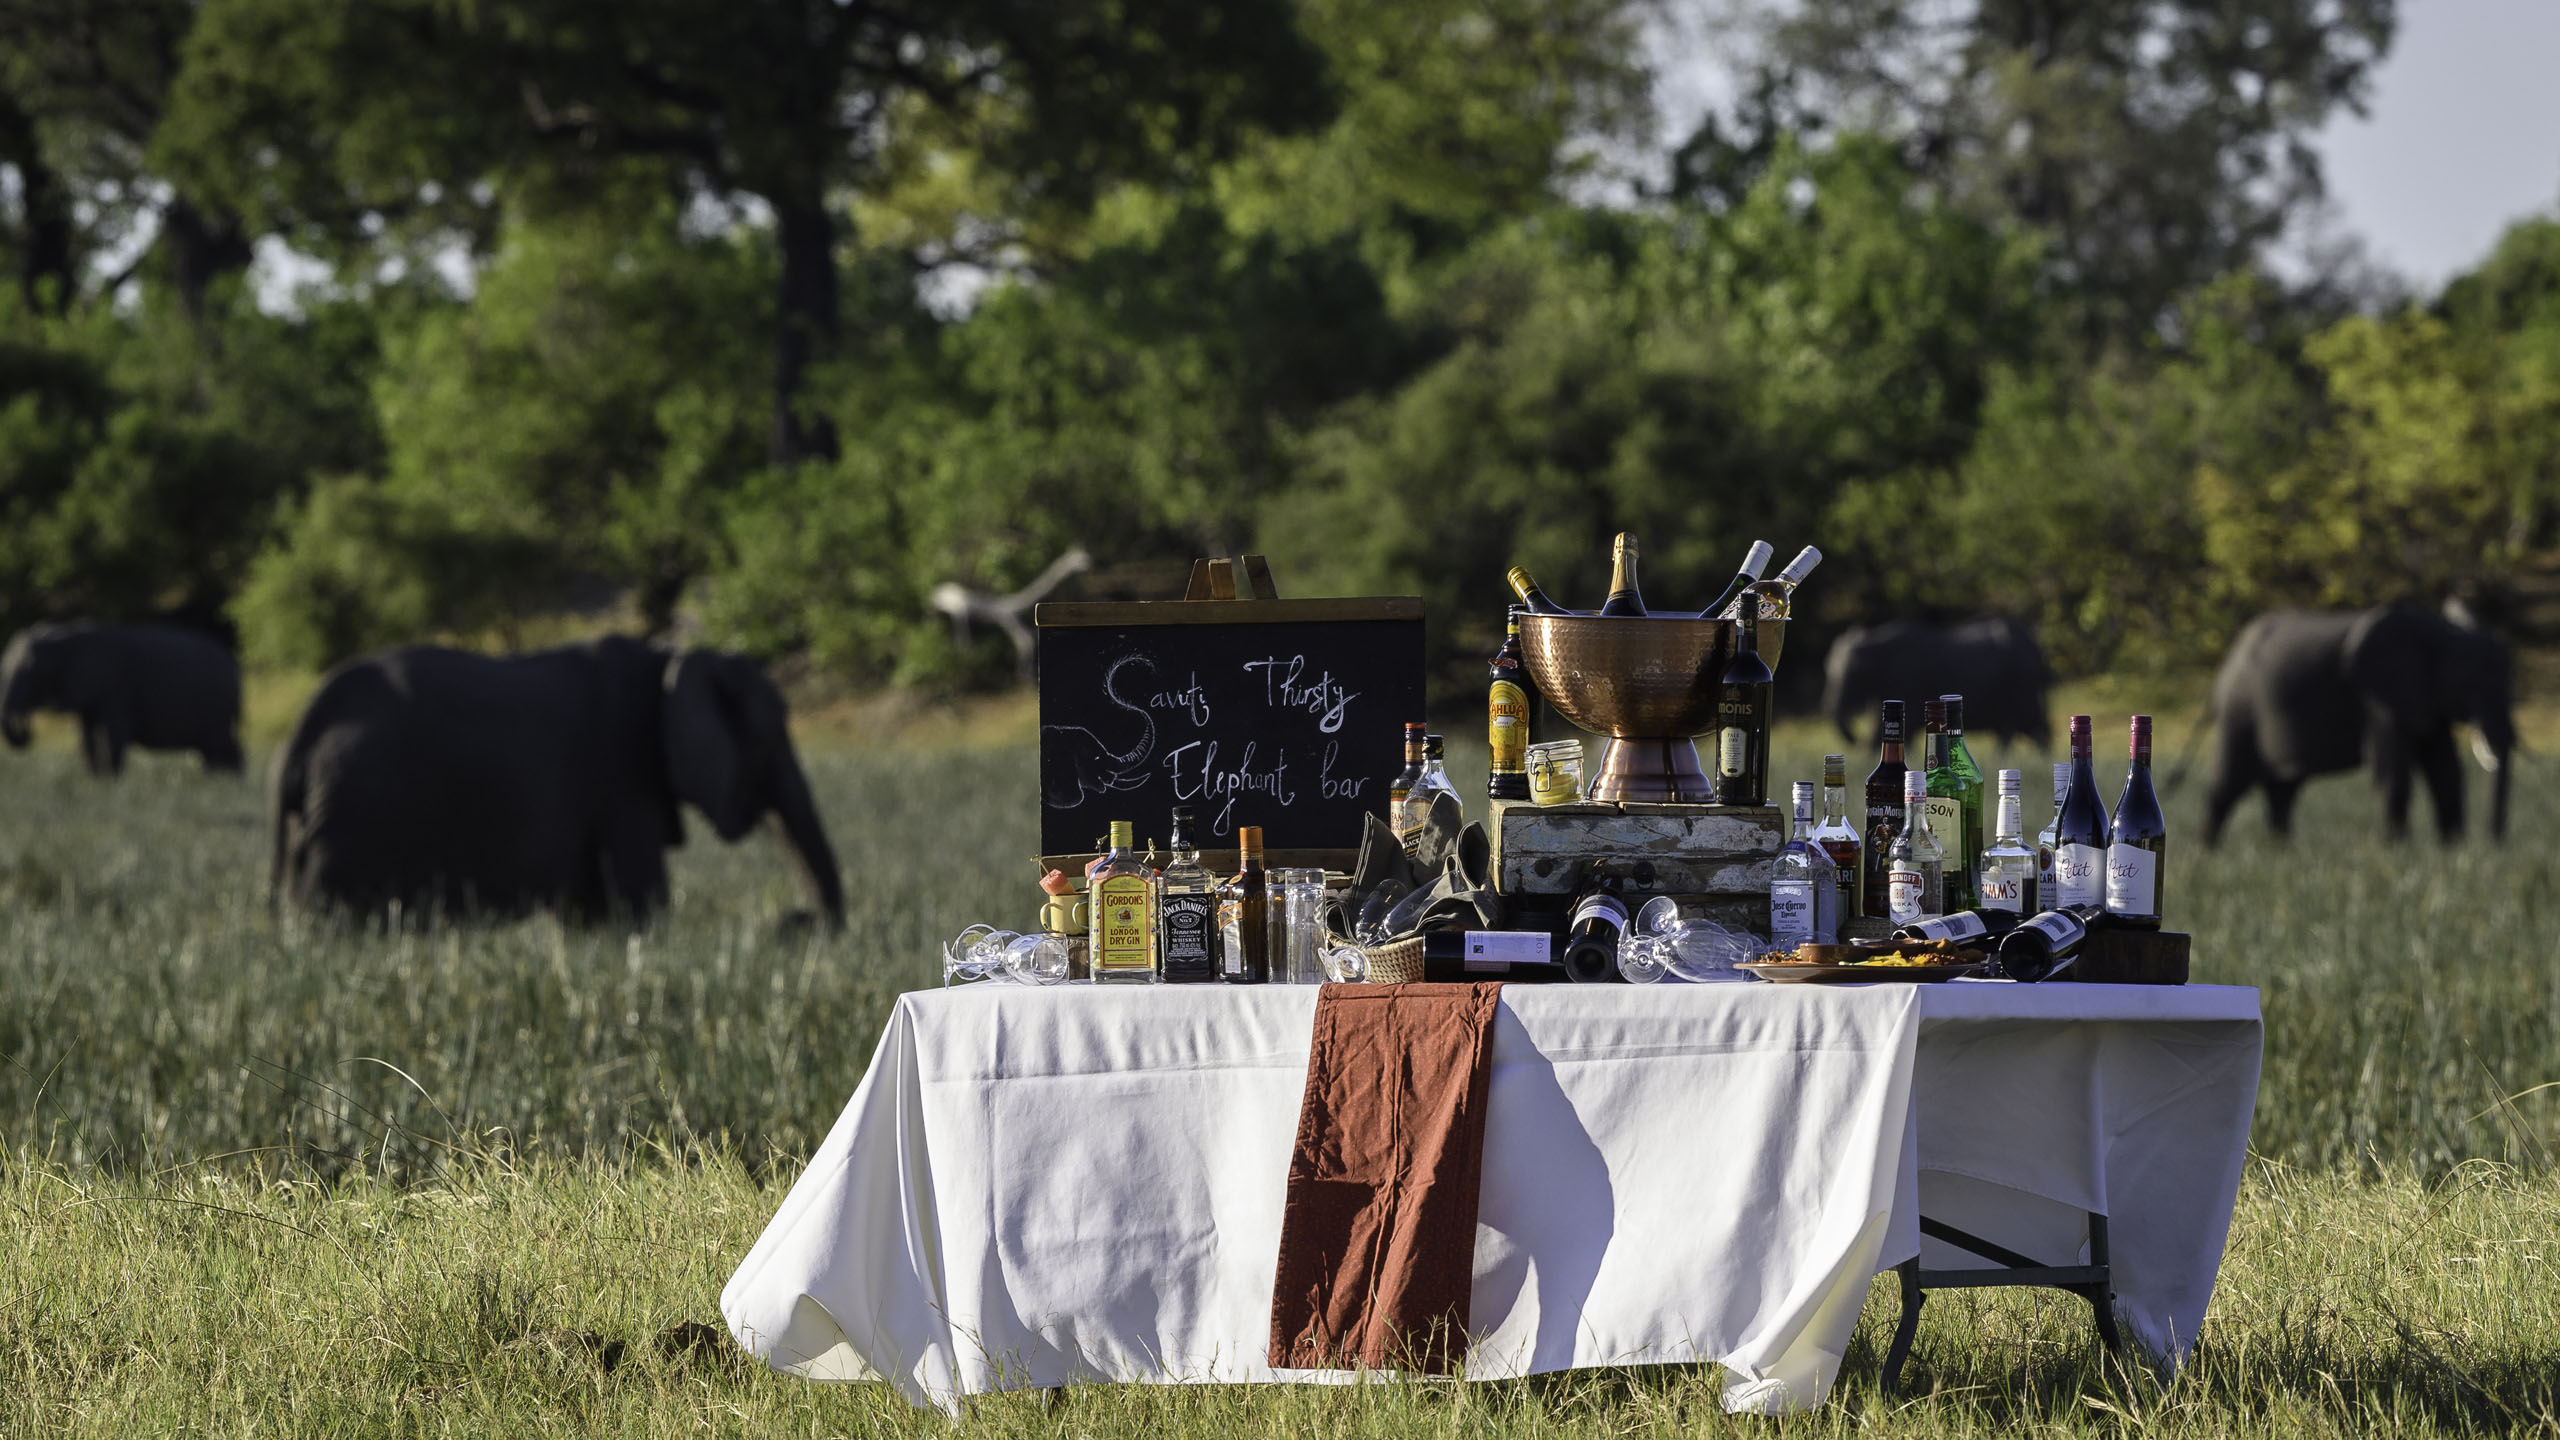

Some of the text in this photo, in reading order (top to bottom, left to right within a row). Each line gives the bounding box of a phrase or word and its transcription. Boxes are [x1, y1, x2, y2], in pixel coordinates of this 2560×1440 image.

[1105, 653, 1362, 738] Savuti Thirsty
[1163, 740, 1371, 836] Elephant bar
[2059, 857, 2094, 880] Petit
[2109, 857, 2140, 880] Petit
[1106, 894, 1144, 907] GORDON'S
[1163, 903, 1181, 918] JACK
[1180, 900, 1209, 916] DANIEL'S
[1109, 936, 1141, 945] DRY GIN
[1110, 928, 1140, 936] LONDON
